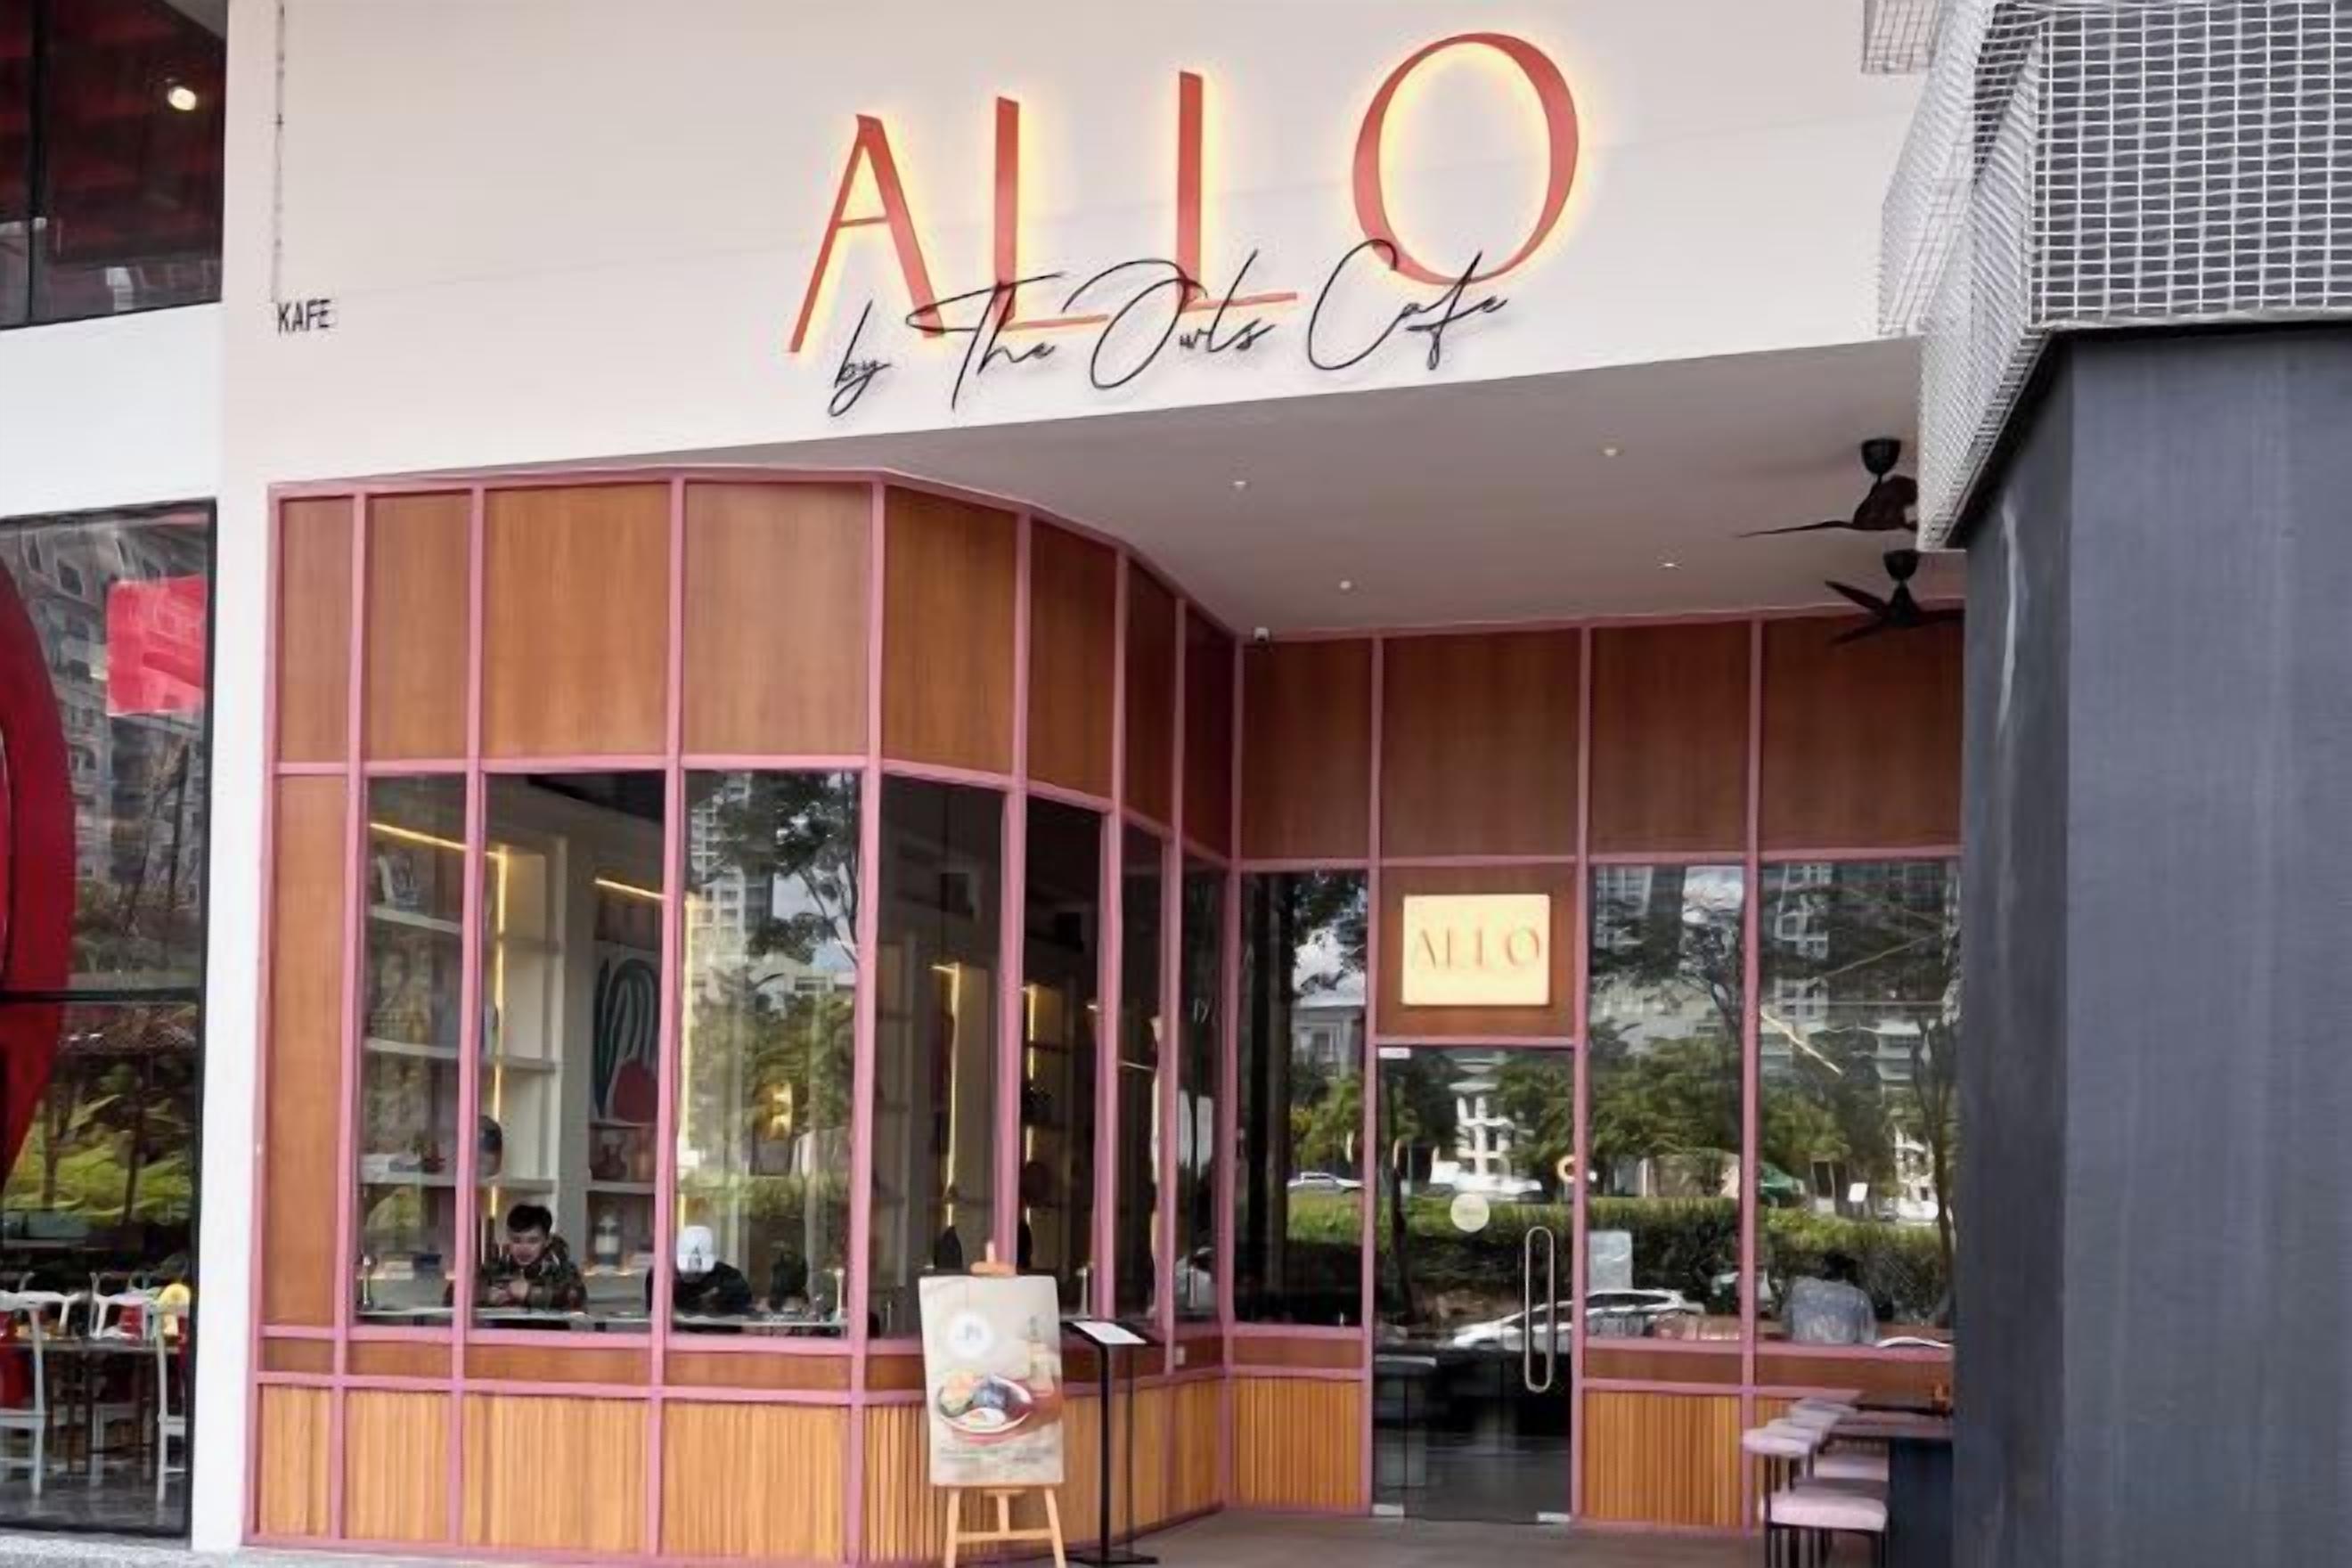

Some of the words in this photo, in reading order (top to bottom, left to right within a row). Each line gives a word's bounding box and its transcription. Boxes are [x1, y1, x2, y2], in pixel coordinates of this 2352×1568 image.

[789, 31, 1580, 354] ALLO
[277, 298, 331, 334] KAFE
[828, 298, 891, 417] by
[905, 271, 1063, 412] The
[1062, 249, 1276, 389] Owls
[1307, 238, 1508, 370] Cafe
